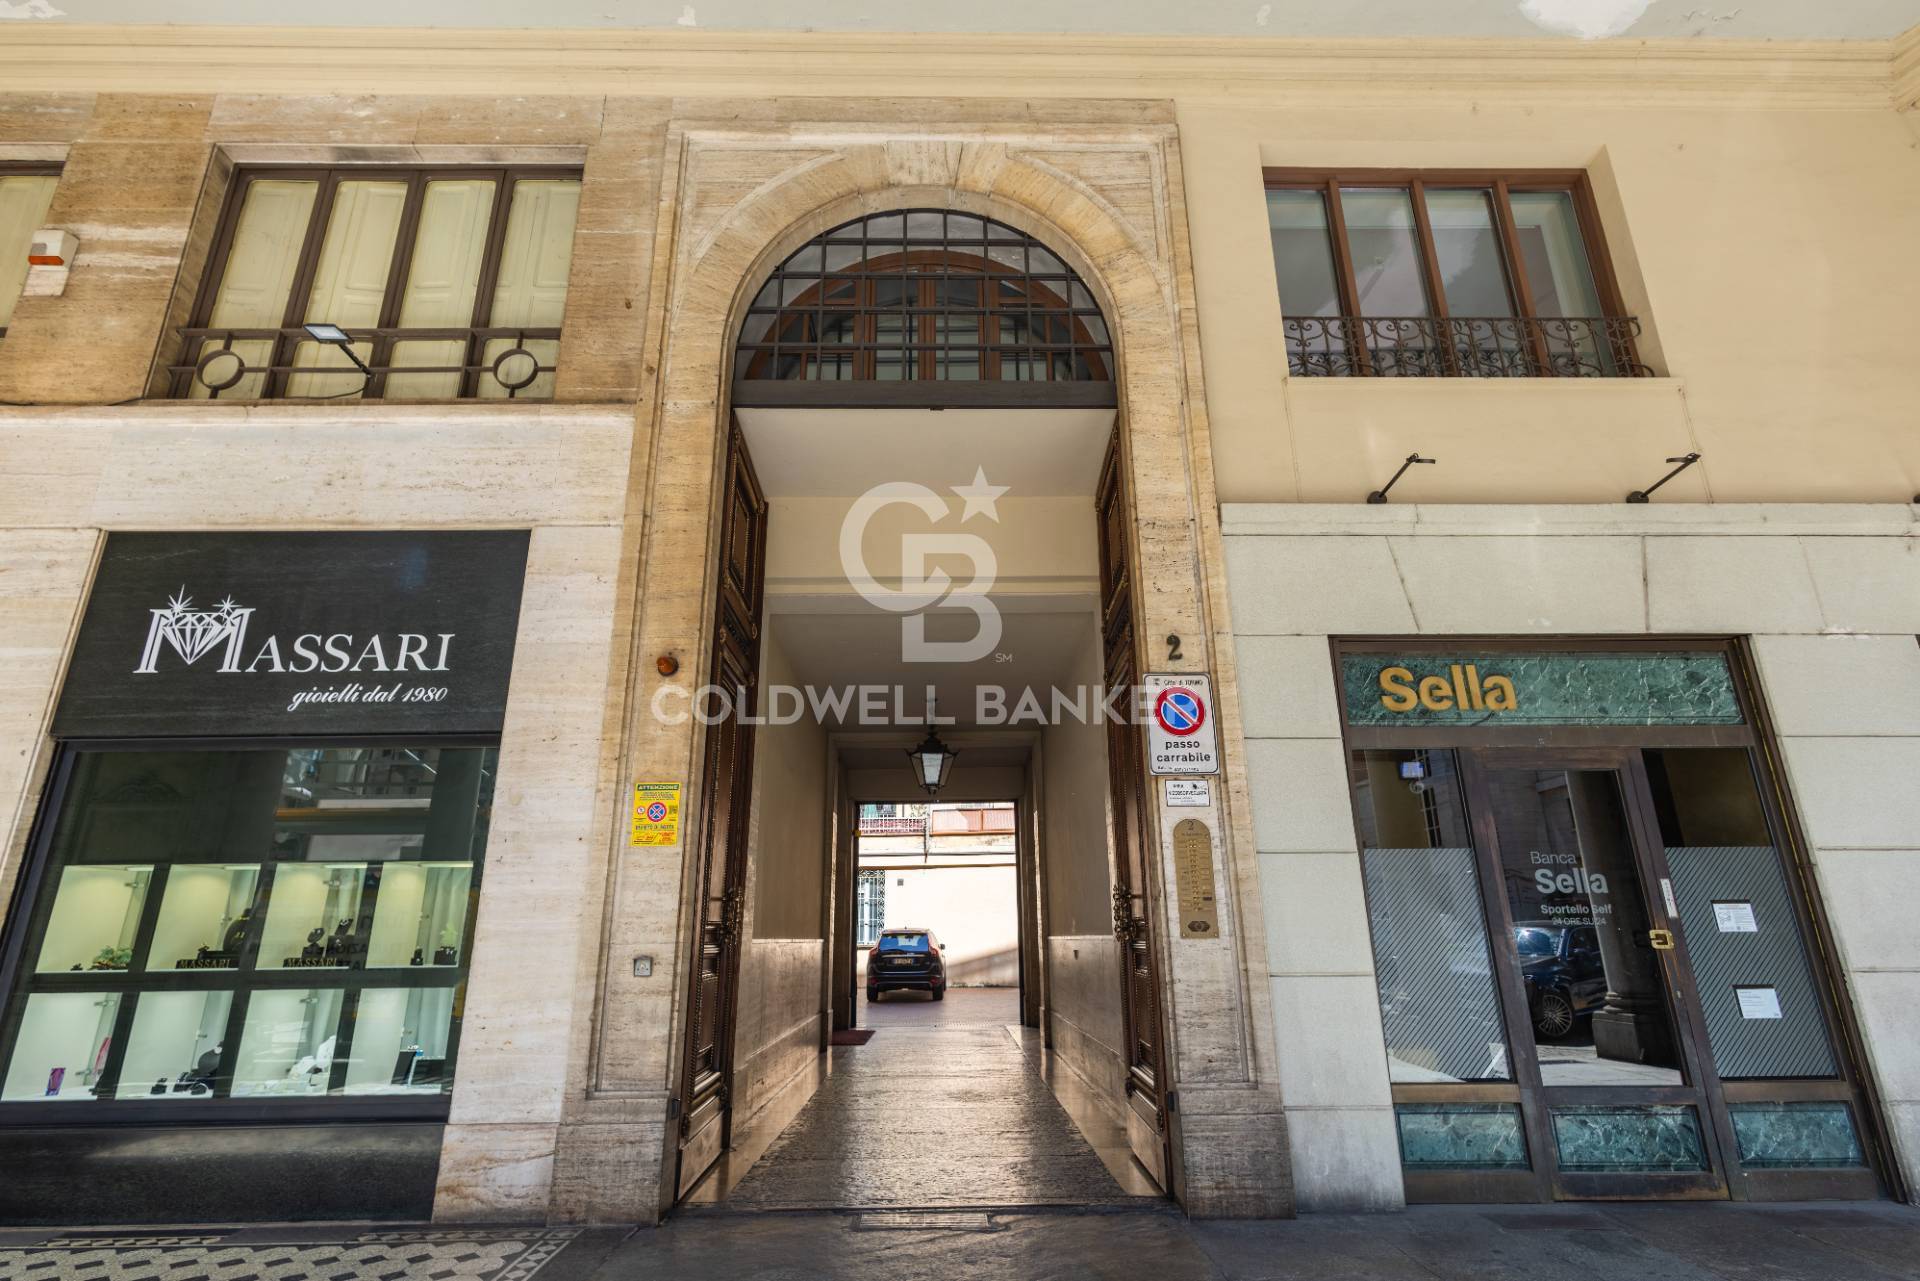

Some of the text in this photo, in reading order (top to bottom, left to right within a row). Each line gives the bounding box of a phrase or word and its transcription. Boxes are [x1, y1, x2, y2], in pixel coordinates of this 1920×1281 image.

[133, 600, 455, 674] MASSARI
[1166, 634, 1183, 661] 2
[1379, 664, 1518, 712] Sella
[287, 683, 448, 712] gioielli dal 1980
[1165, 741, 1200, 750] passo
[1156, 753, 1211, 762] carrabile
[1530, 851, 1577, 864] Banca
[1535, 868, 1609, 894] Sella
[1540, 903, 1612, 916] Sportello Self
[1563, 917, 1581, 926] ORE
[181, 959, 230, 969] MASSARI
[288, 958, 337, 968] MASSARI
